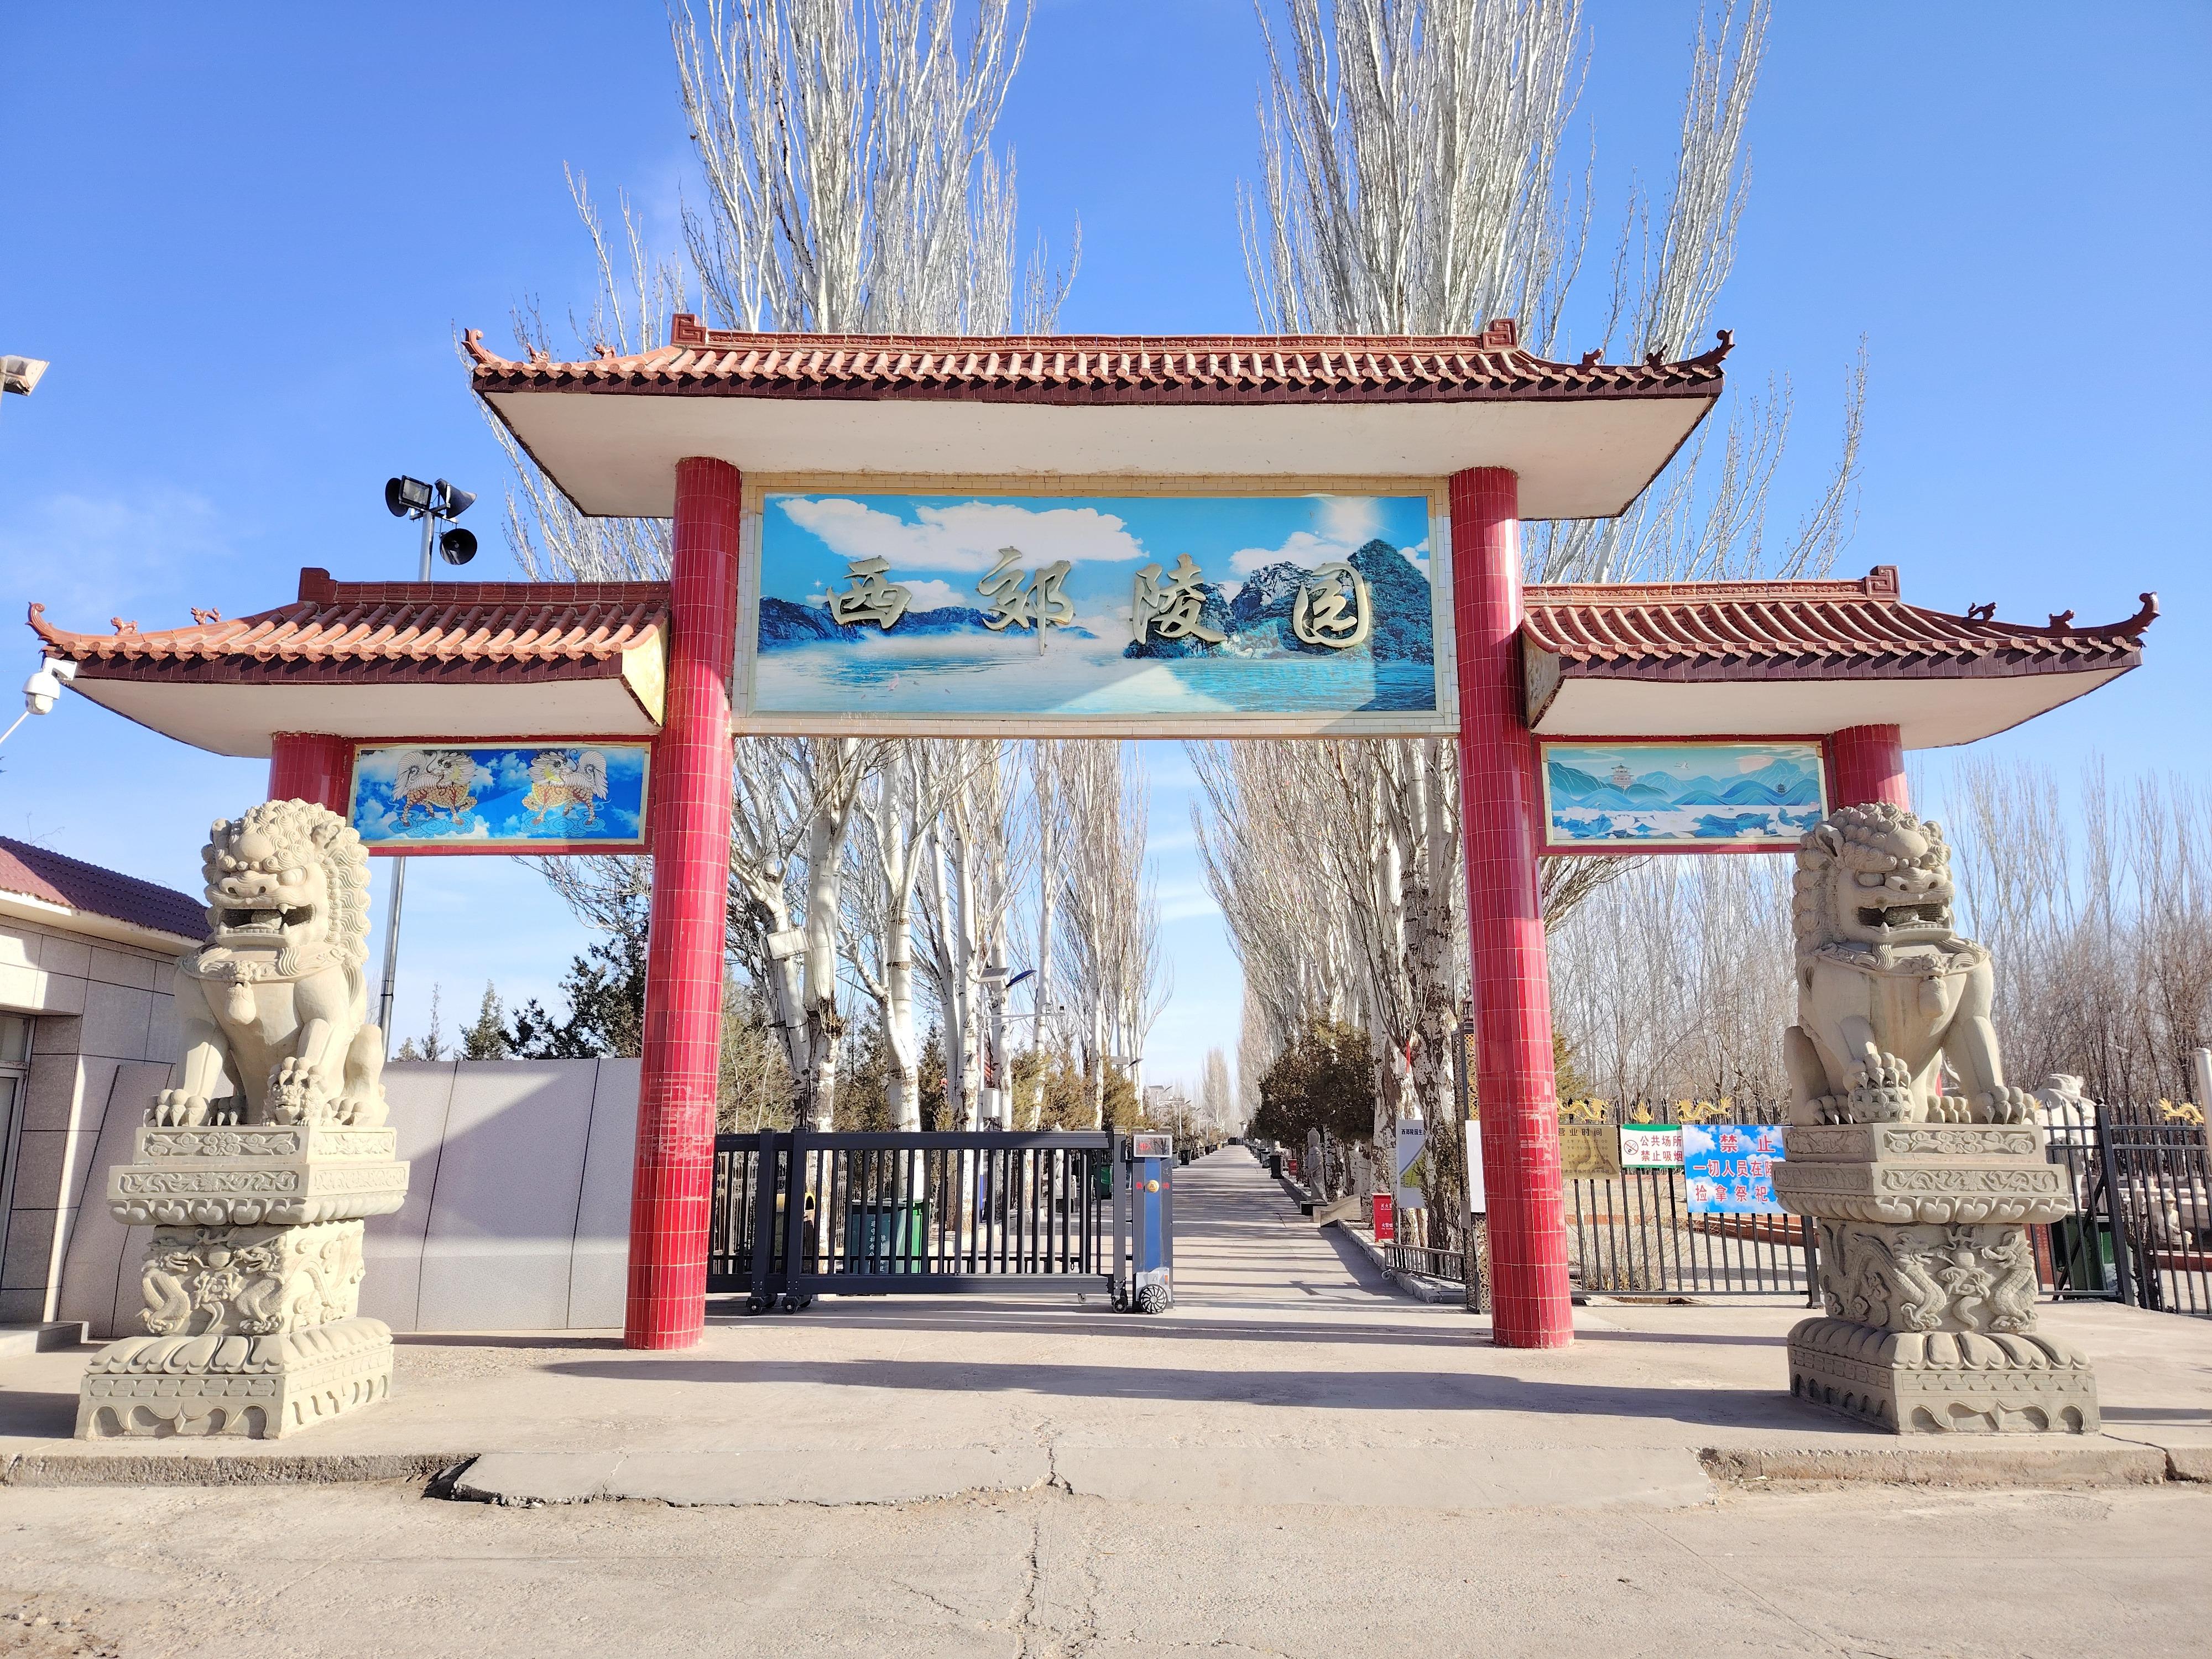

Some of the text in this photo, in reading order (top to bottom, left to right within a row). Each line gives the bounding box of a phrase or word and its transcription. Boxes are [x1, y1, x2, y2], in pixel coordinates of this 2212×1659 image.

[827, 546, 1370, 656] 西郊陵园
[1558, 1128, 1602, 1136] 营业时间
[1640, 1135, 1682, 1147] 公共场所
[1720, 1134, 1775, 1152] 禁止
[1641, 1150, 1683, 1162] 禁止吸烟
[1695, 1185, 1768, 1202] 捡拿祭祀
